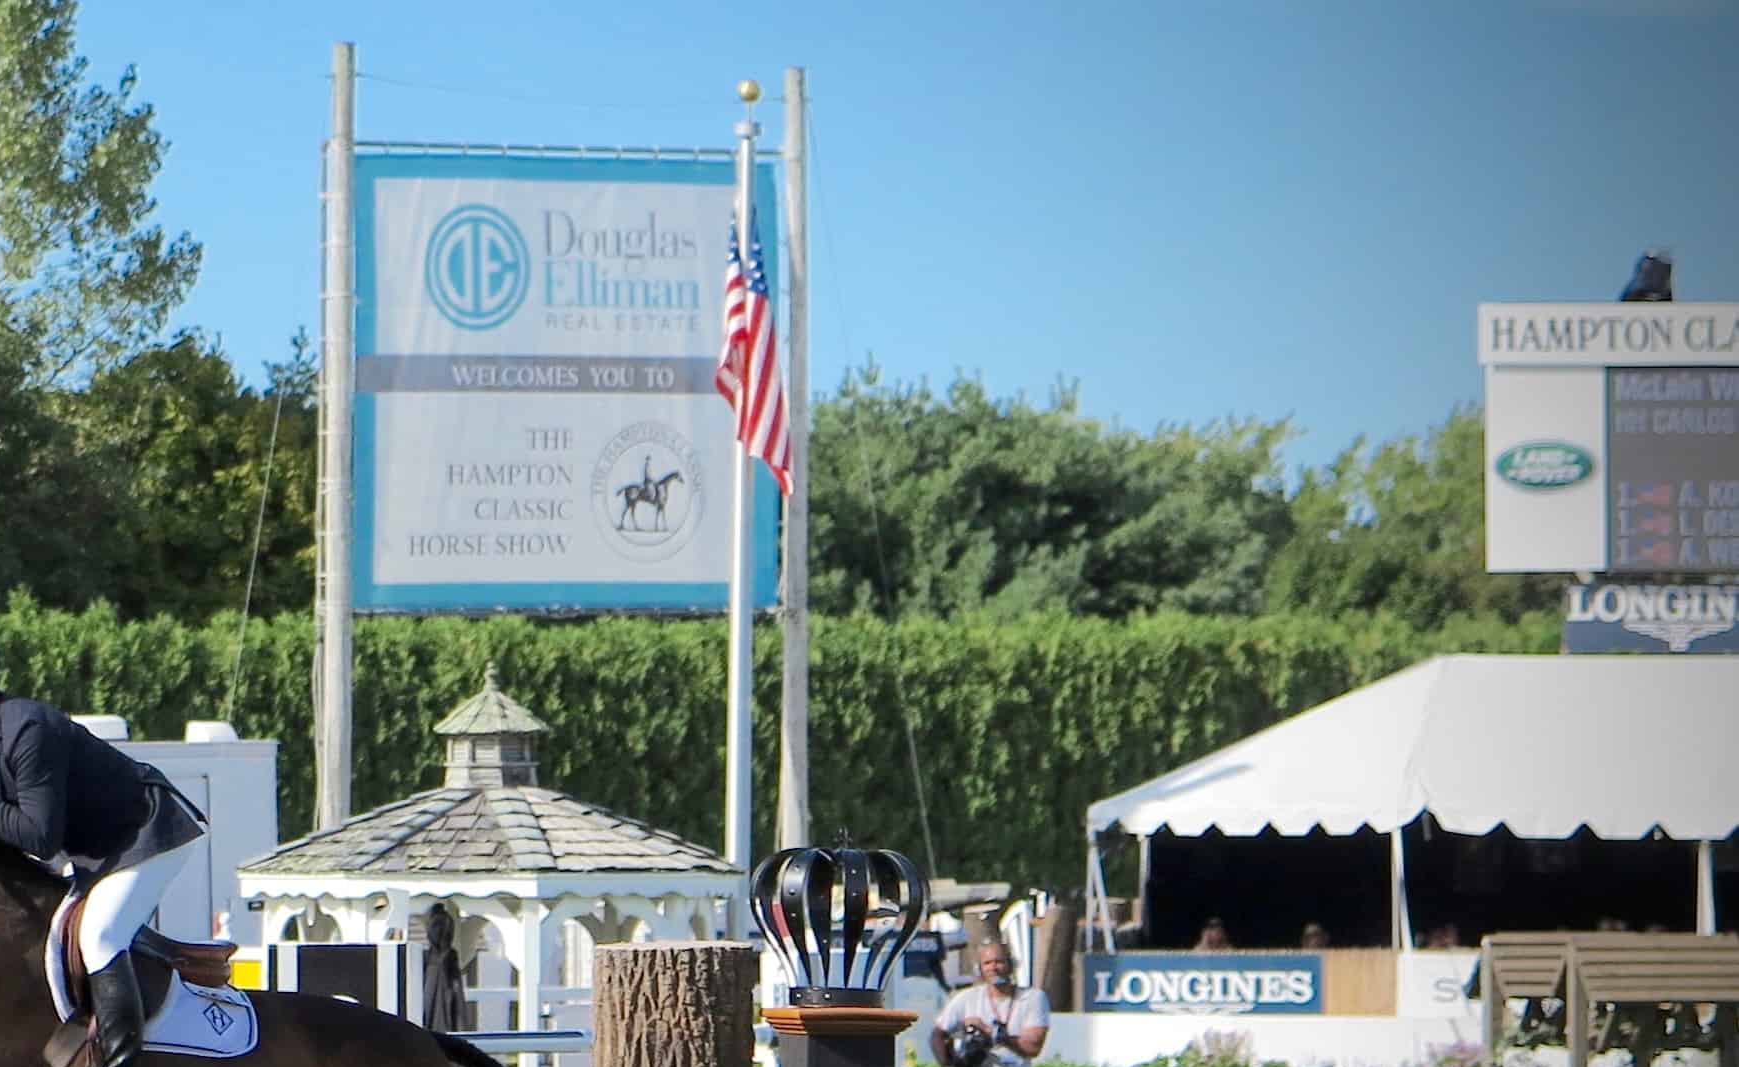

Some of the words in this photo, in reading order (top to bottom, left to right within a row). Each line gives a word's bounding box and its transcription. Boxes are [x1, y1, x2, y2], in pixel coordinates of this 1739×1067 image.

[542, 208, 699, 270] Douglas
[542, 258, 701, 310] Elliman
[545, 313, 603, 332] REAL
[615, 313, 701, 333] ESTATE
[1491, 316, 1673, 352] HAMPTON
[452, 364, 579, 388] WELCOMES
[590, 365, 636, 388] YOU
[644, 366, 675, 389] TO
[525, 427, 574, 450] THE
[446, 463, 574, 486] HAMPTON
[472, 498, 574, 521] CLASSIC
[409, 533, 486, 557] HORSE
[495, 533, 572, 557] SHOW
[1566, 584, 1739, 622] LONGIN
[1094, 969, 1314, 1004] LONGINES
